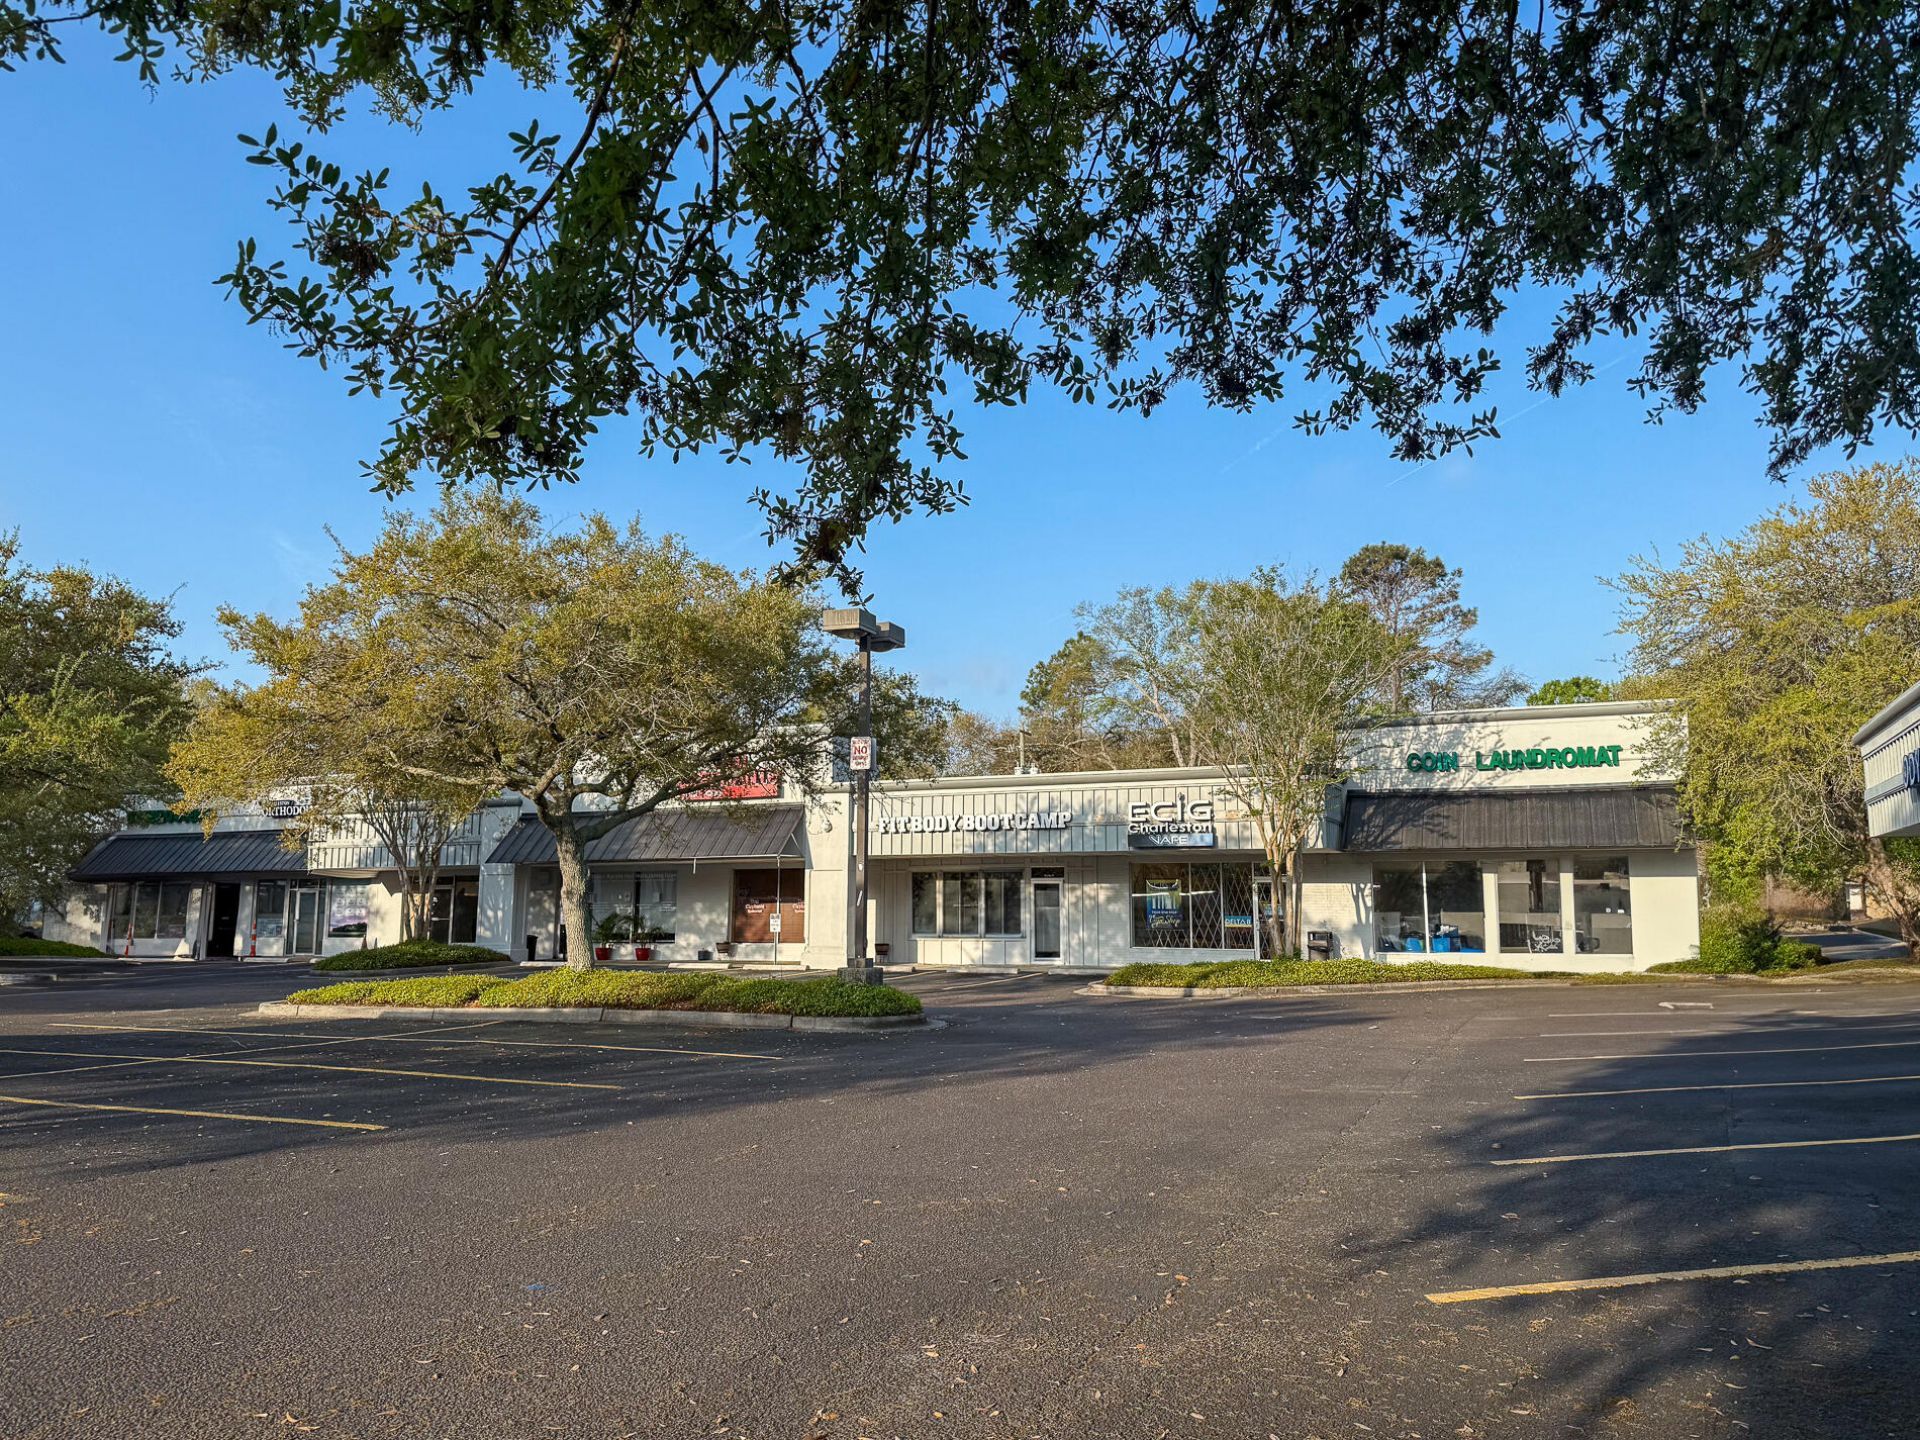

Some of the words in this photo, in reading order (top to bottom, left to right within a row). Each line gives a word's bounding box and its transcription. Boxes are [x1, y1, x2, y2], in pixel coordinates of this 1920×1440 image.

[854, 746, 868, 755] NO
[1406, 751, 1458, 772] COIN
[1476, 745, 1623, 771] LAUNDROMAT
[878, 816, 910, 833] FIT
[910, 815, 961, 833] BODY
[963, 814, 1013, 831] BOOT
[1014, 811, 1072, 830] CAMP
[1128, 822, 1212, 834] Charleston
[1149, 835, 1188, 845] VAPE
